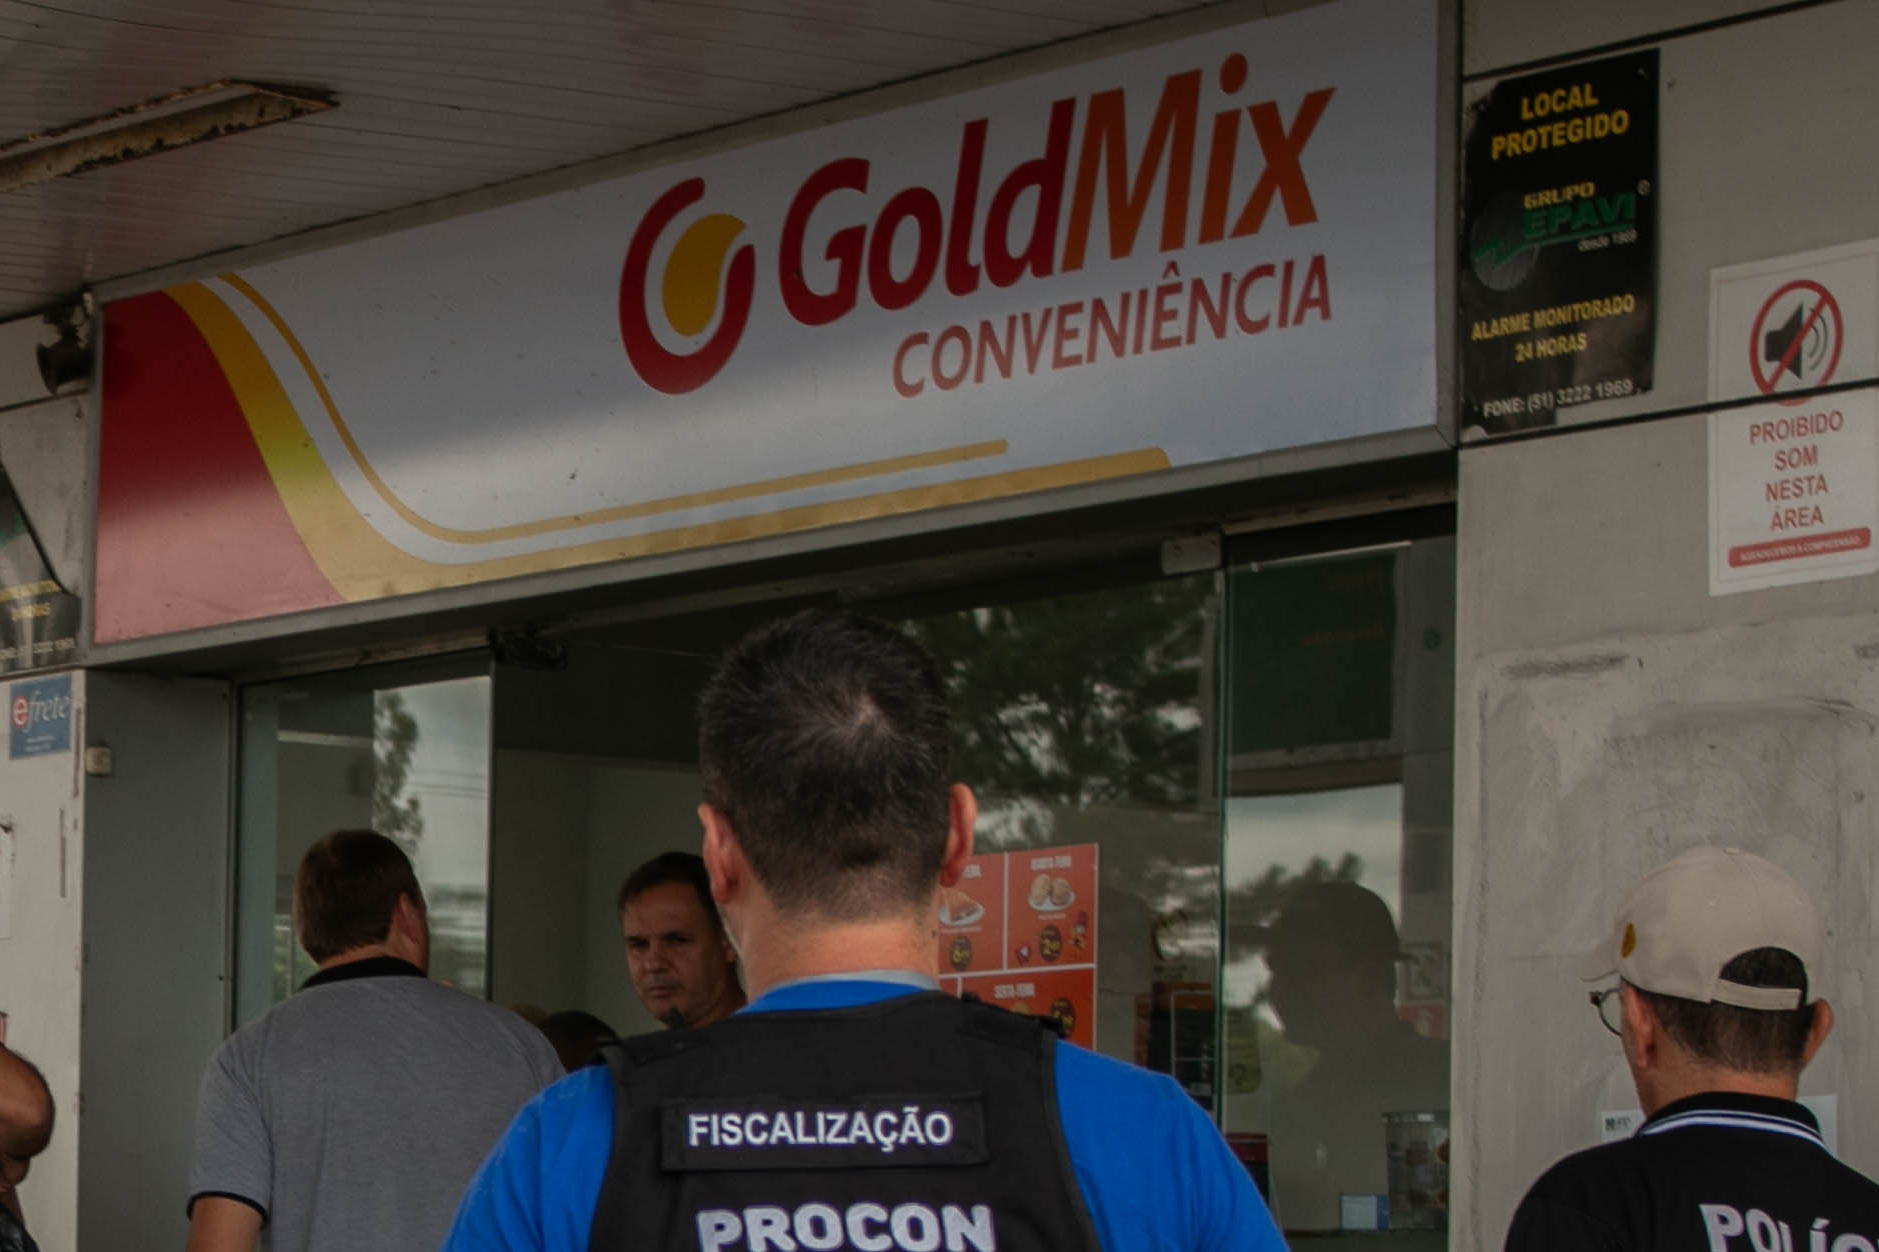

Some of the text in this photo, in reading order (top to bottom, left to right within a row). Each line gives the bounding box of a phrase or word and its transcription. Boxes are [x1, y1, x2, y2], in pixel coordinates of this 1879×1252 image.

[1521, 82, 1599, 121] LOCAL
[1491, 108, 1631, 161] PROTEGIDO
[779, 53, 1335, 327] GoldMix
[1523, 181, 1595, 210] GRUPO
[1523, 193, 1635, 238] EPAVI
[892, 254, 1333, 398] CONVENIÊNCIA
[1471, 293, 1636, 341] ALARME MONITORADO
[1514, 332, 1588, 363] 24 HORAS
[1482, 396, 1525, 418] FONE:
[1596, 379, 1634, 398] 1969
[1749, 410, 1844, 445] PROIBIDO
[1774, 444, 1819, 471] SOM
[1766, 474, 1829, 503] NESTA
[1770, 504, 1825, 531] ÁREA
[688, 1106, 954, 1152] FISCALIZAÇÃO
